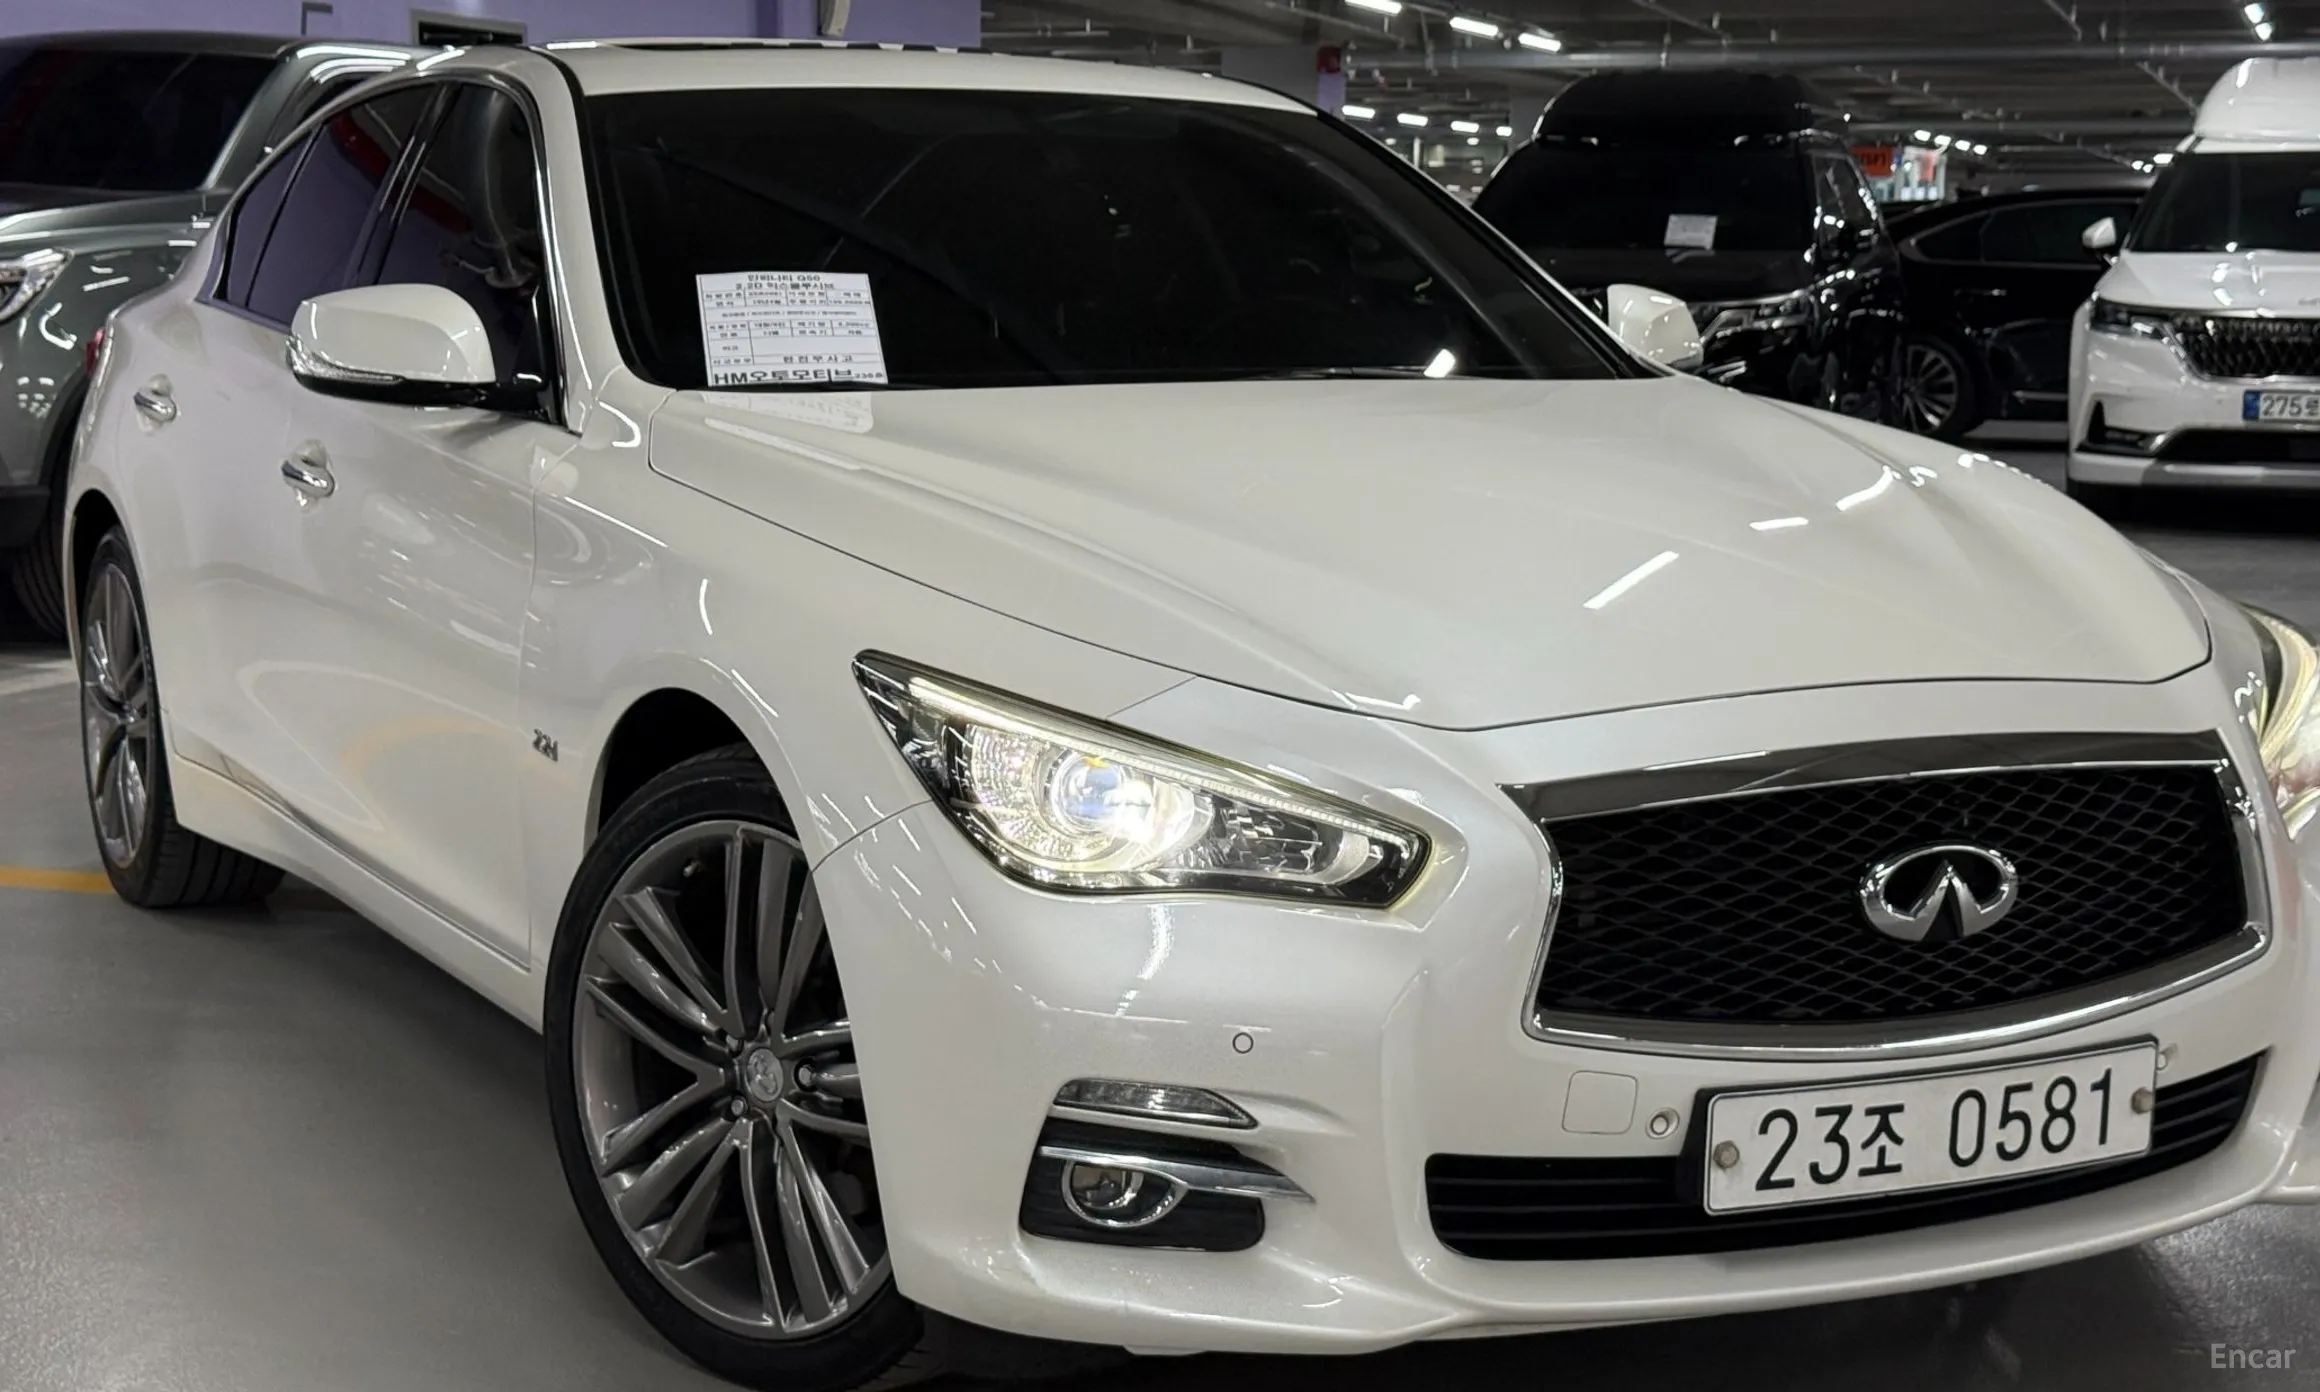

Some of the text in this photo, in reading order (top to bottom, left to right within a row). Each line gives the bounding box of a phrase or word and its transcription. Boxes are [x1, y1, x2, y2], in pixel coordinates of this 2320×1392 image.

[747, 274, 820, 282] 인피니티 Q50
[714, 368, 854, 384] HM오토모티브
[1755, 1067, 2113, 1191] 23조 0581
